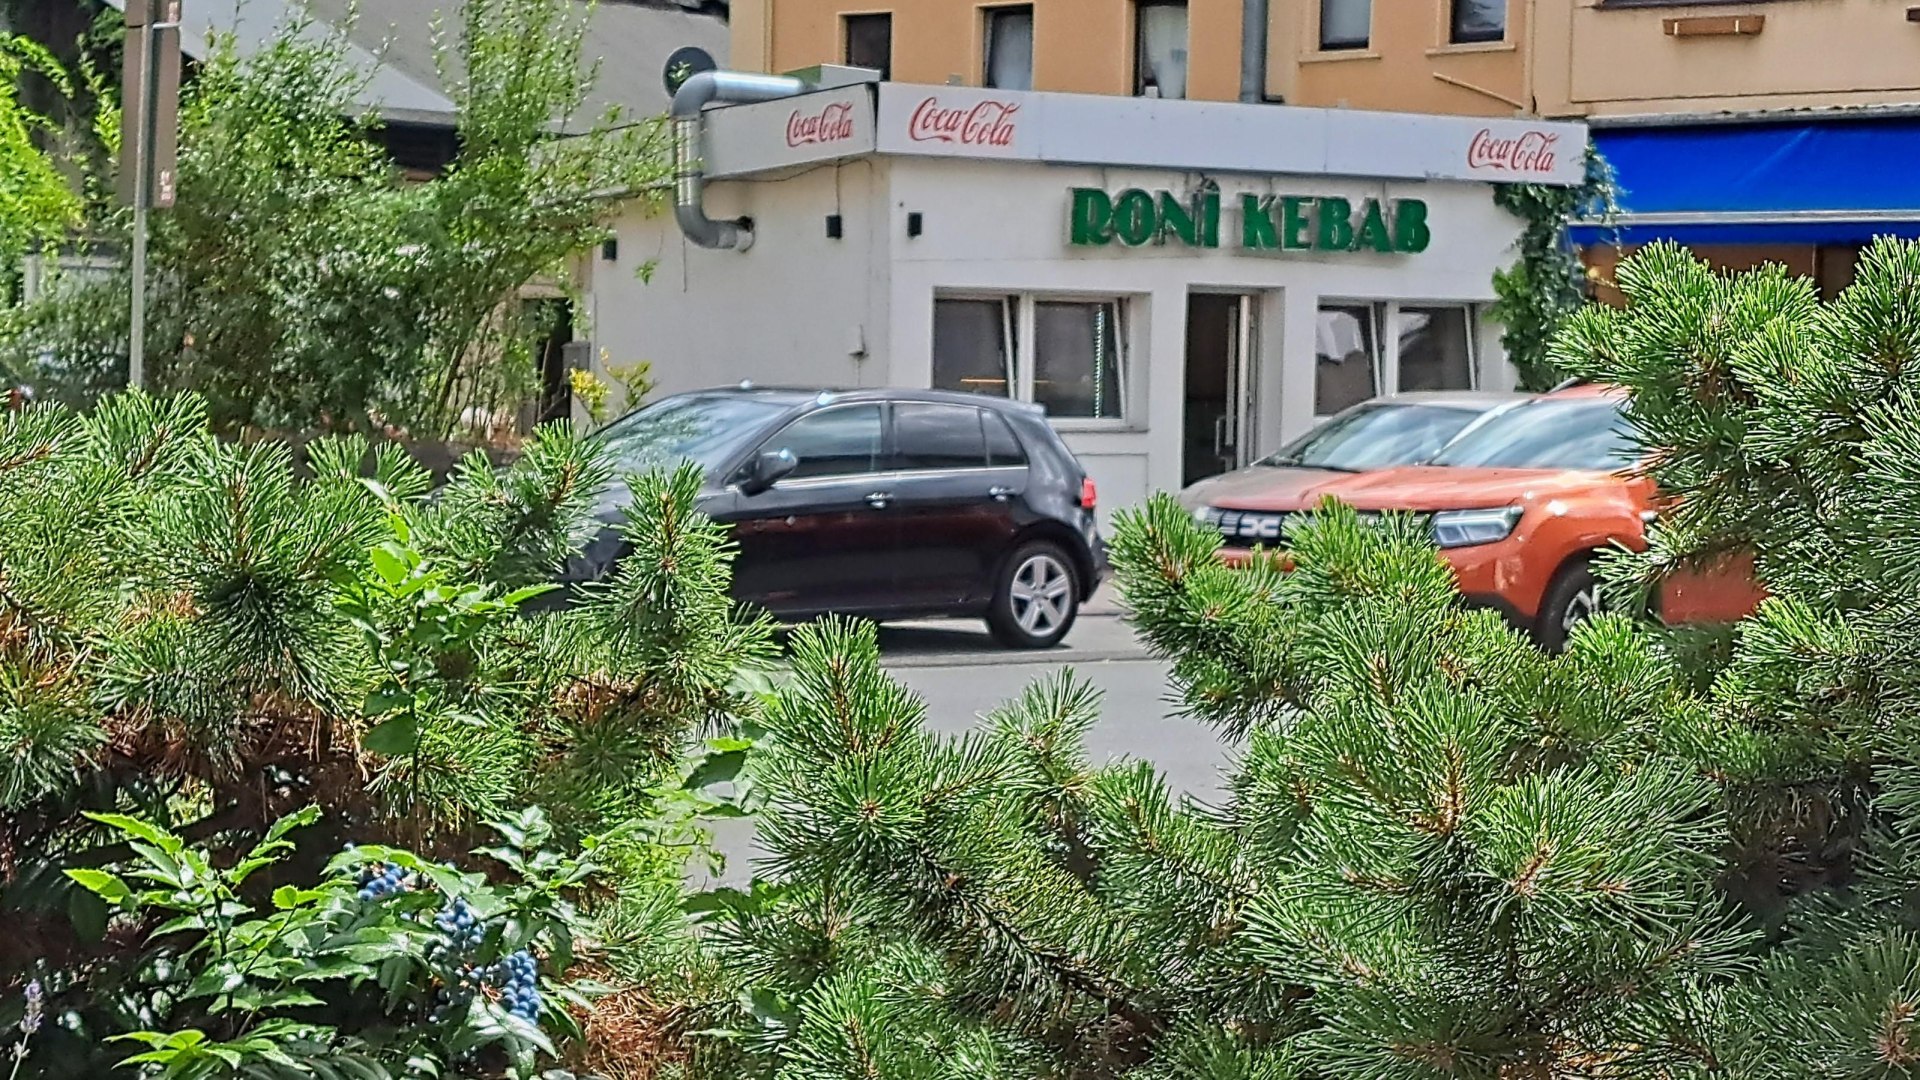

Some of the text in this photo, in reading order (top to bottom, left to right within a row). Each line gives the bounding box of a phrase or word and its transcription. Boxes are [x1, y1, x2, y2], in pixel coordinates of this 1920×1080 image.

[787, 102, 853, 147] Coca-Cola
[909, 97, 1021, 146] Coca-Cola
[1468, 128, 1560, 172] Coca-Cola
[1242, 194, 1430, 254] KEBAB
